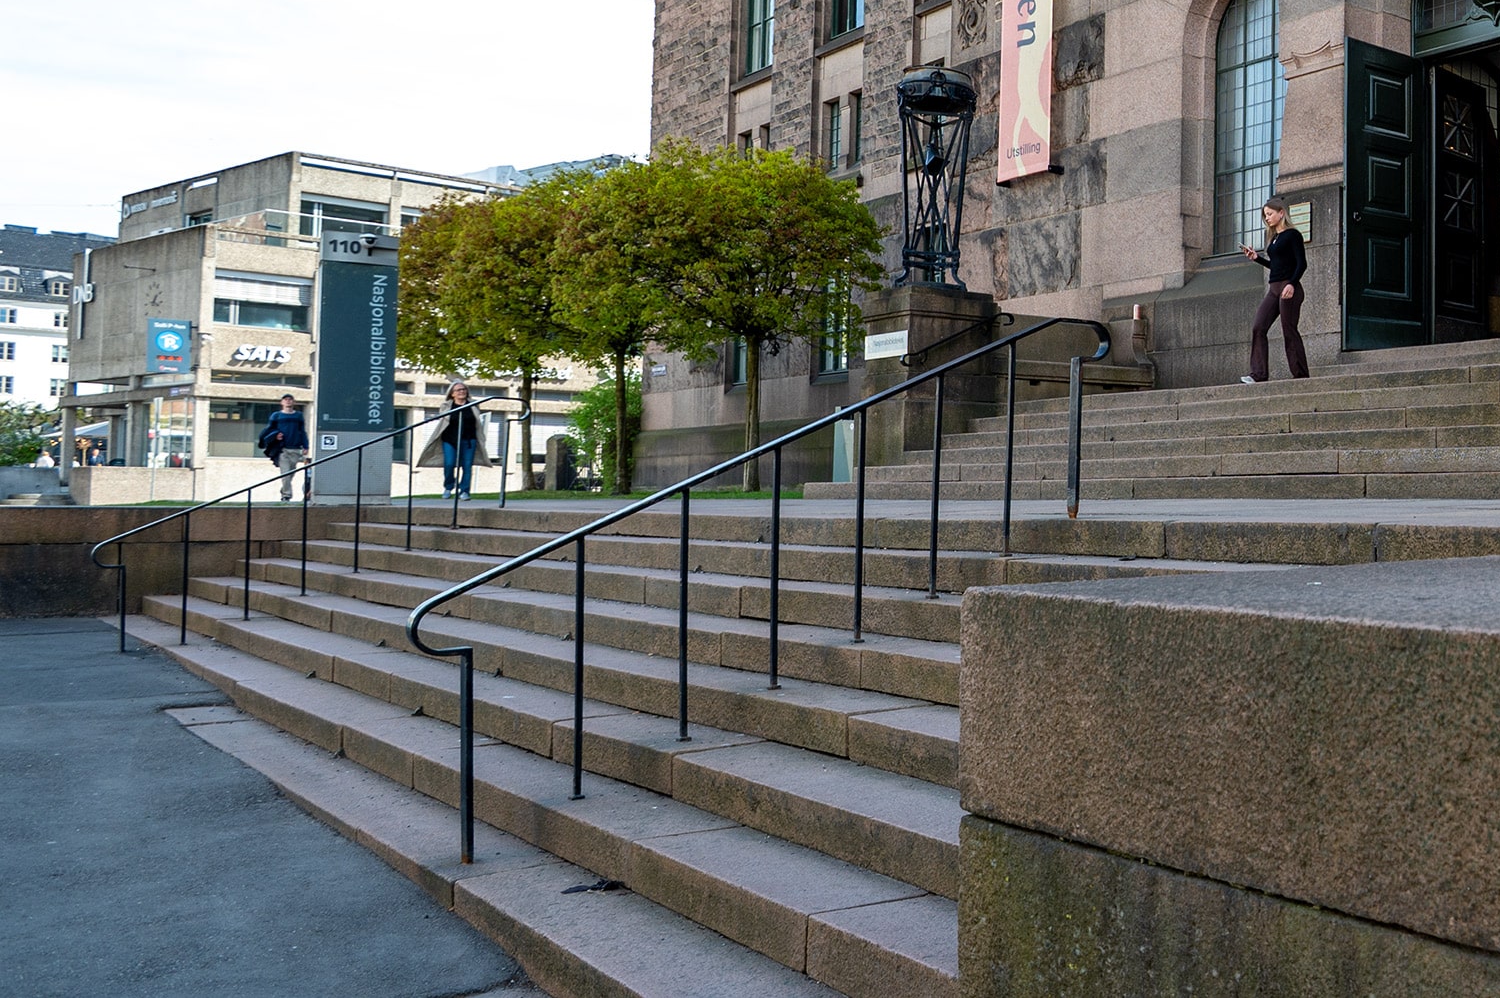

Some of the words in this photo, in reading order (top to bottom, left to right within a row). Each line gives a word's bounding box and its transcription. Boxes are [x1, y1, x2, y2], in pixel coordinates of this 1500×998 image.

[1006, 142, 1041, 159] Utstilling
[73, 283, 93, 304] DNB
[233, 343, 294, 363] SATS
[367, 274, 388, 425] Nasjonalbiblioteket
